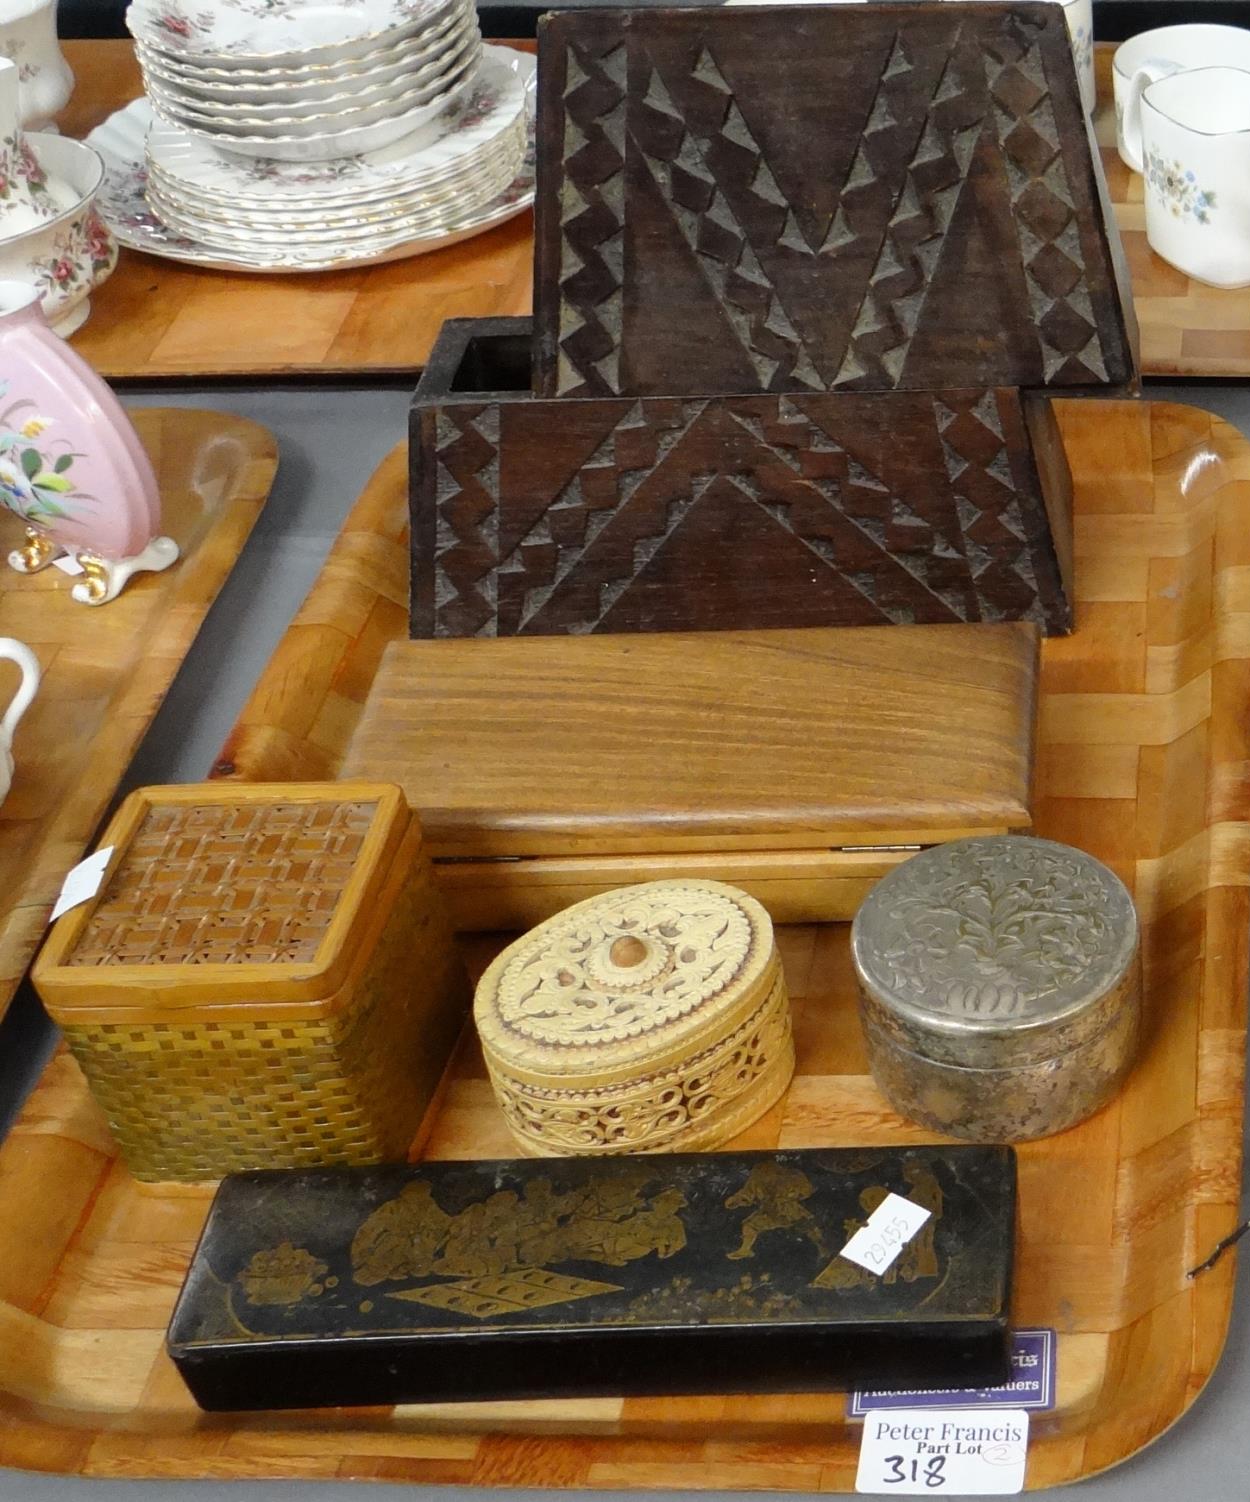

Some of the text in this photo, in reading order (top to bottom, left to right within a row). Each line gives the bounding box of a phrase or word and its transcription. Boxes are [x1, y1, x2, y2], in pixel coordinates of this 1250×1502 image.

[863, 1216, 909, 1266] 29455
[876, 1422, 1022, 1442] Peter Francis
[916, 1442, 983, 1455] Part Lot
[883, 1455, 947, 1488] 318
